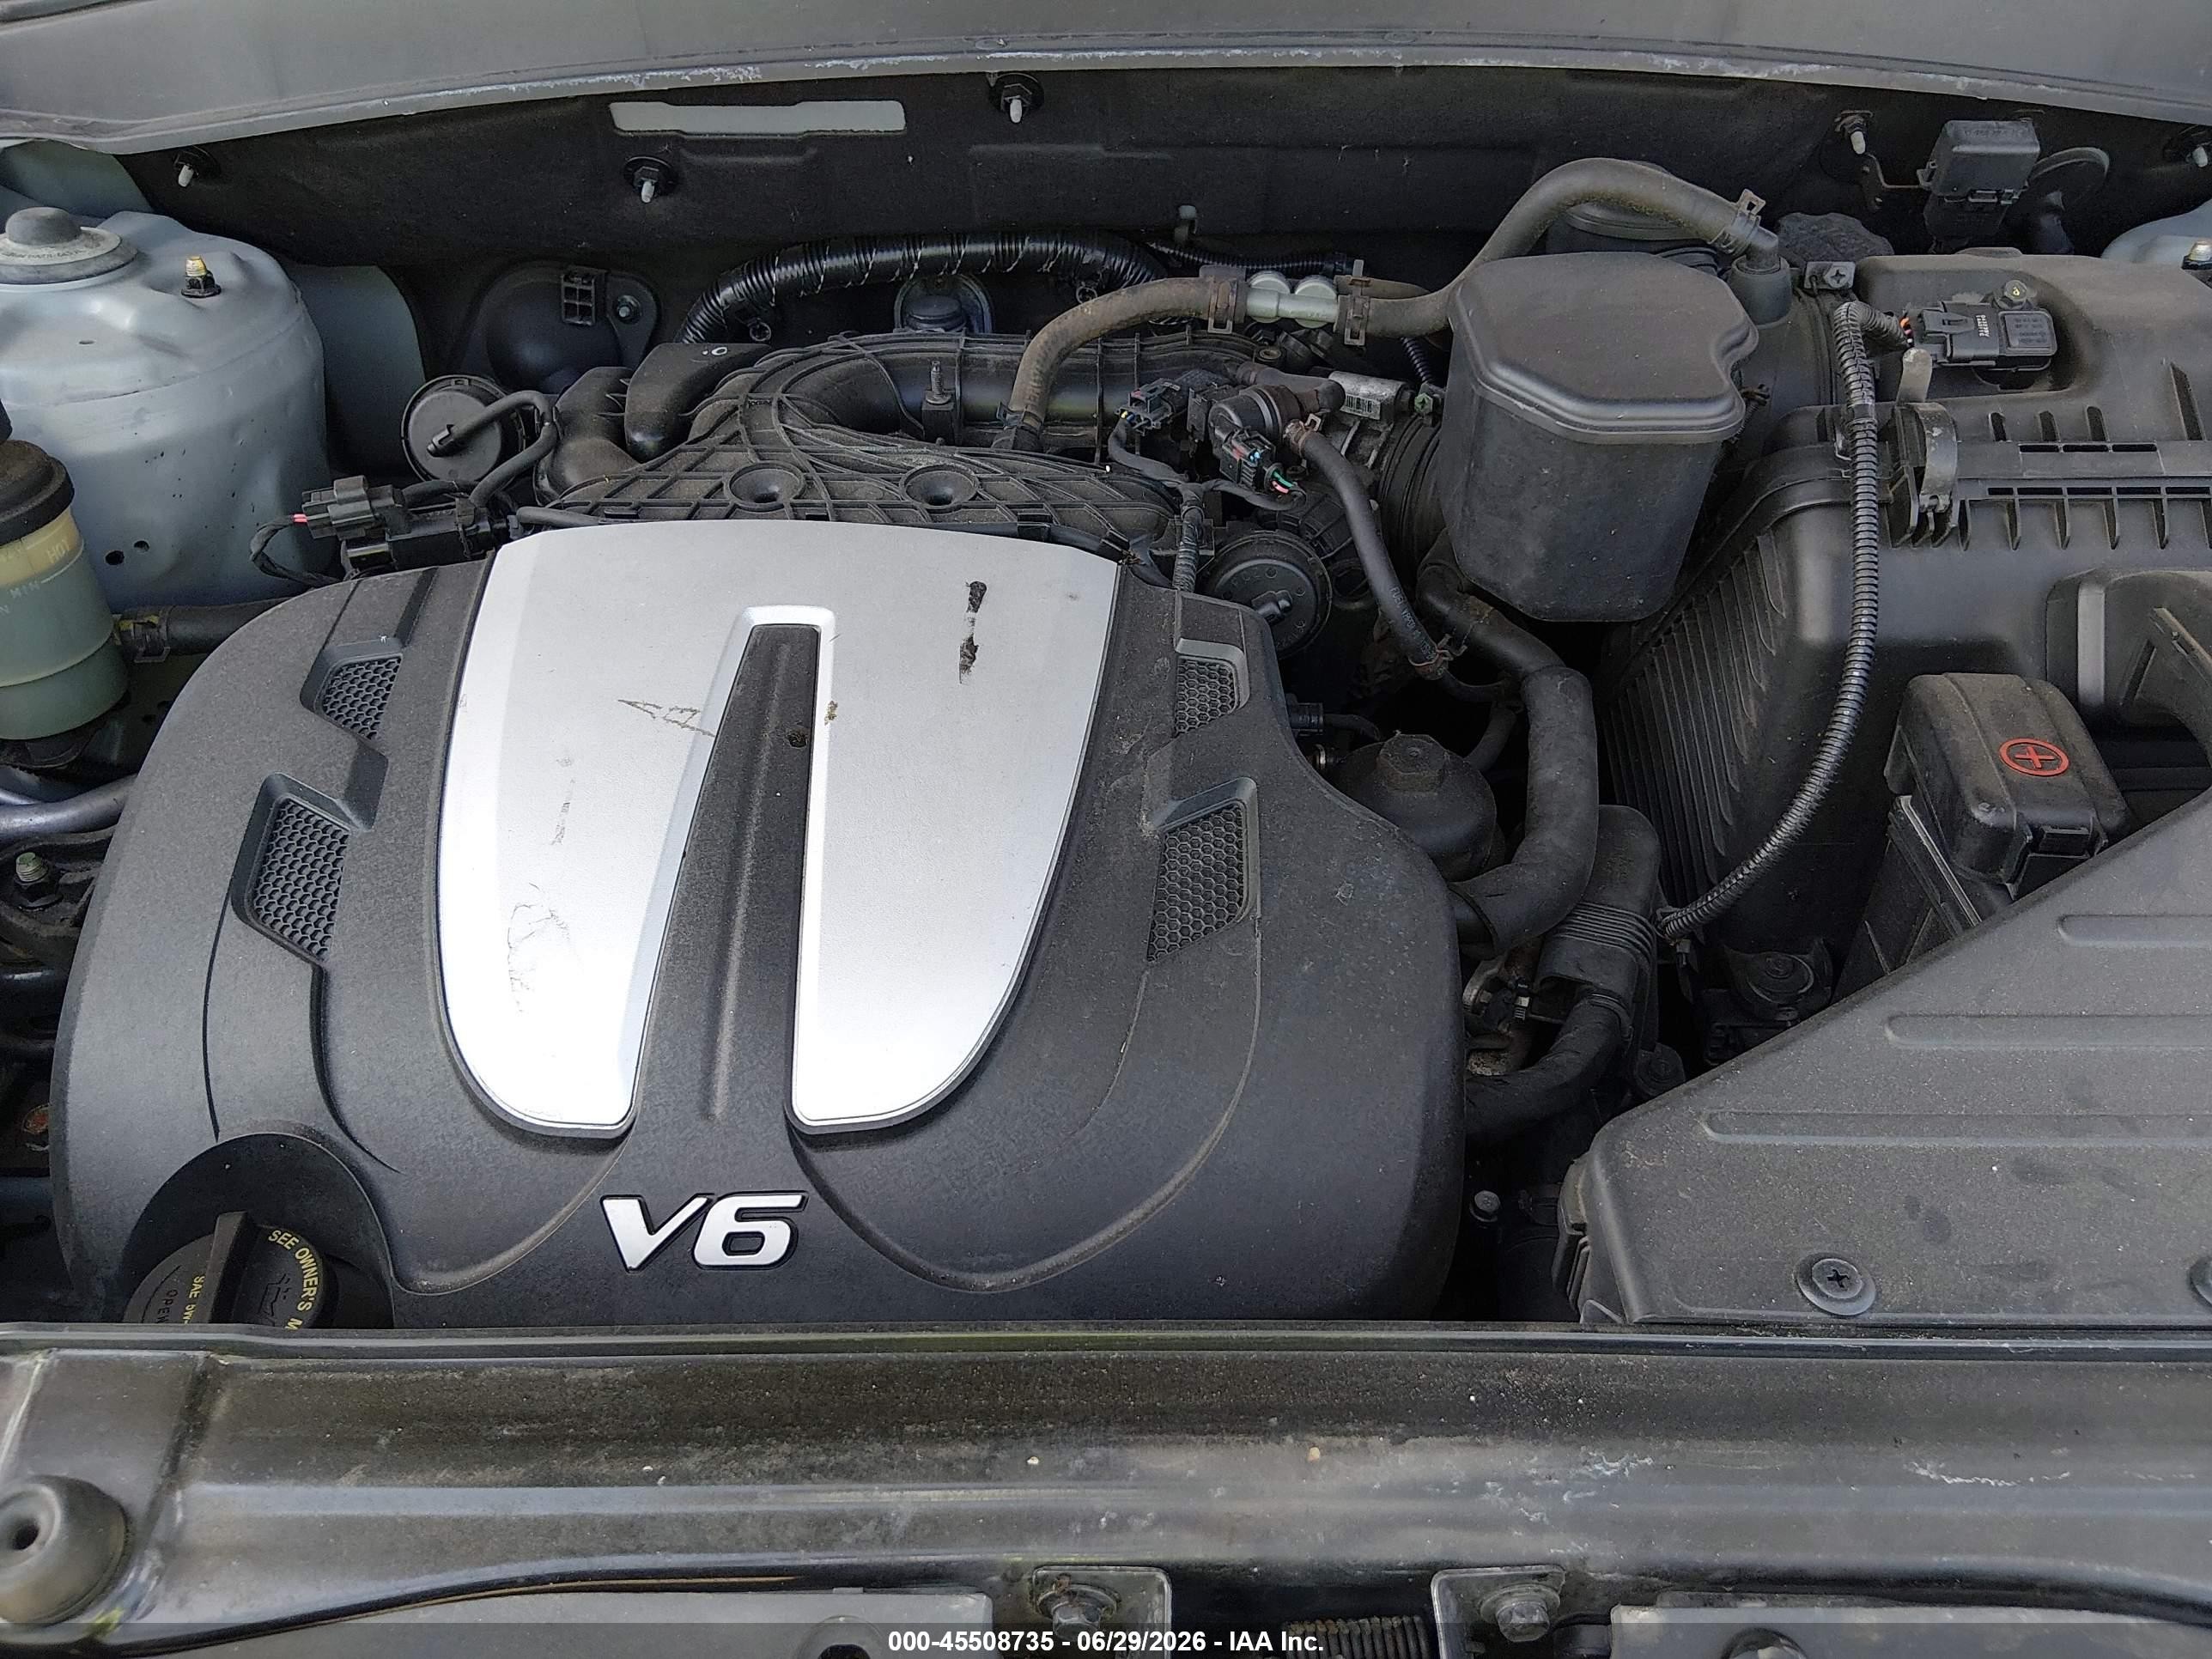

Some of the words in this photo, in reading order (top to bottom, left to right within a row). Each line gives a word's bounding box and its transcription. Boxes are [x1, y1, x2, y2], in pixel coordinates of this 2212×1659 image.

[268, 1230, 300, 1250] SEE
[295, 1248, 319, 1312] OWNER'S
[600, 1191, 807, 1272] V6
[188, 1275, 205, 1299] SAE
